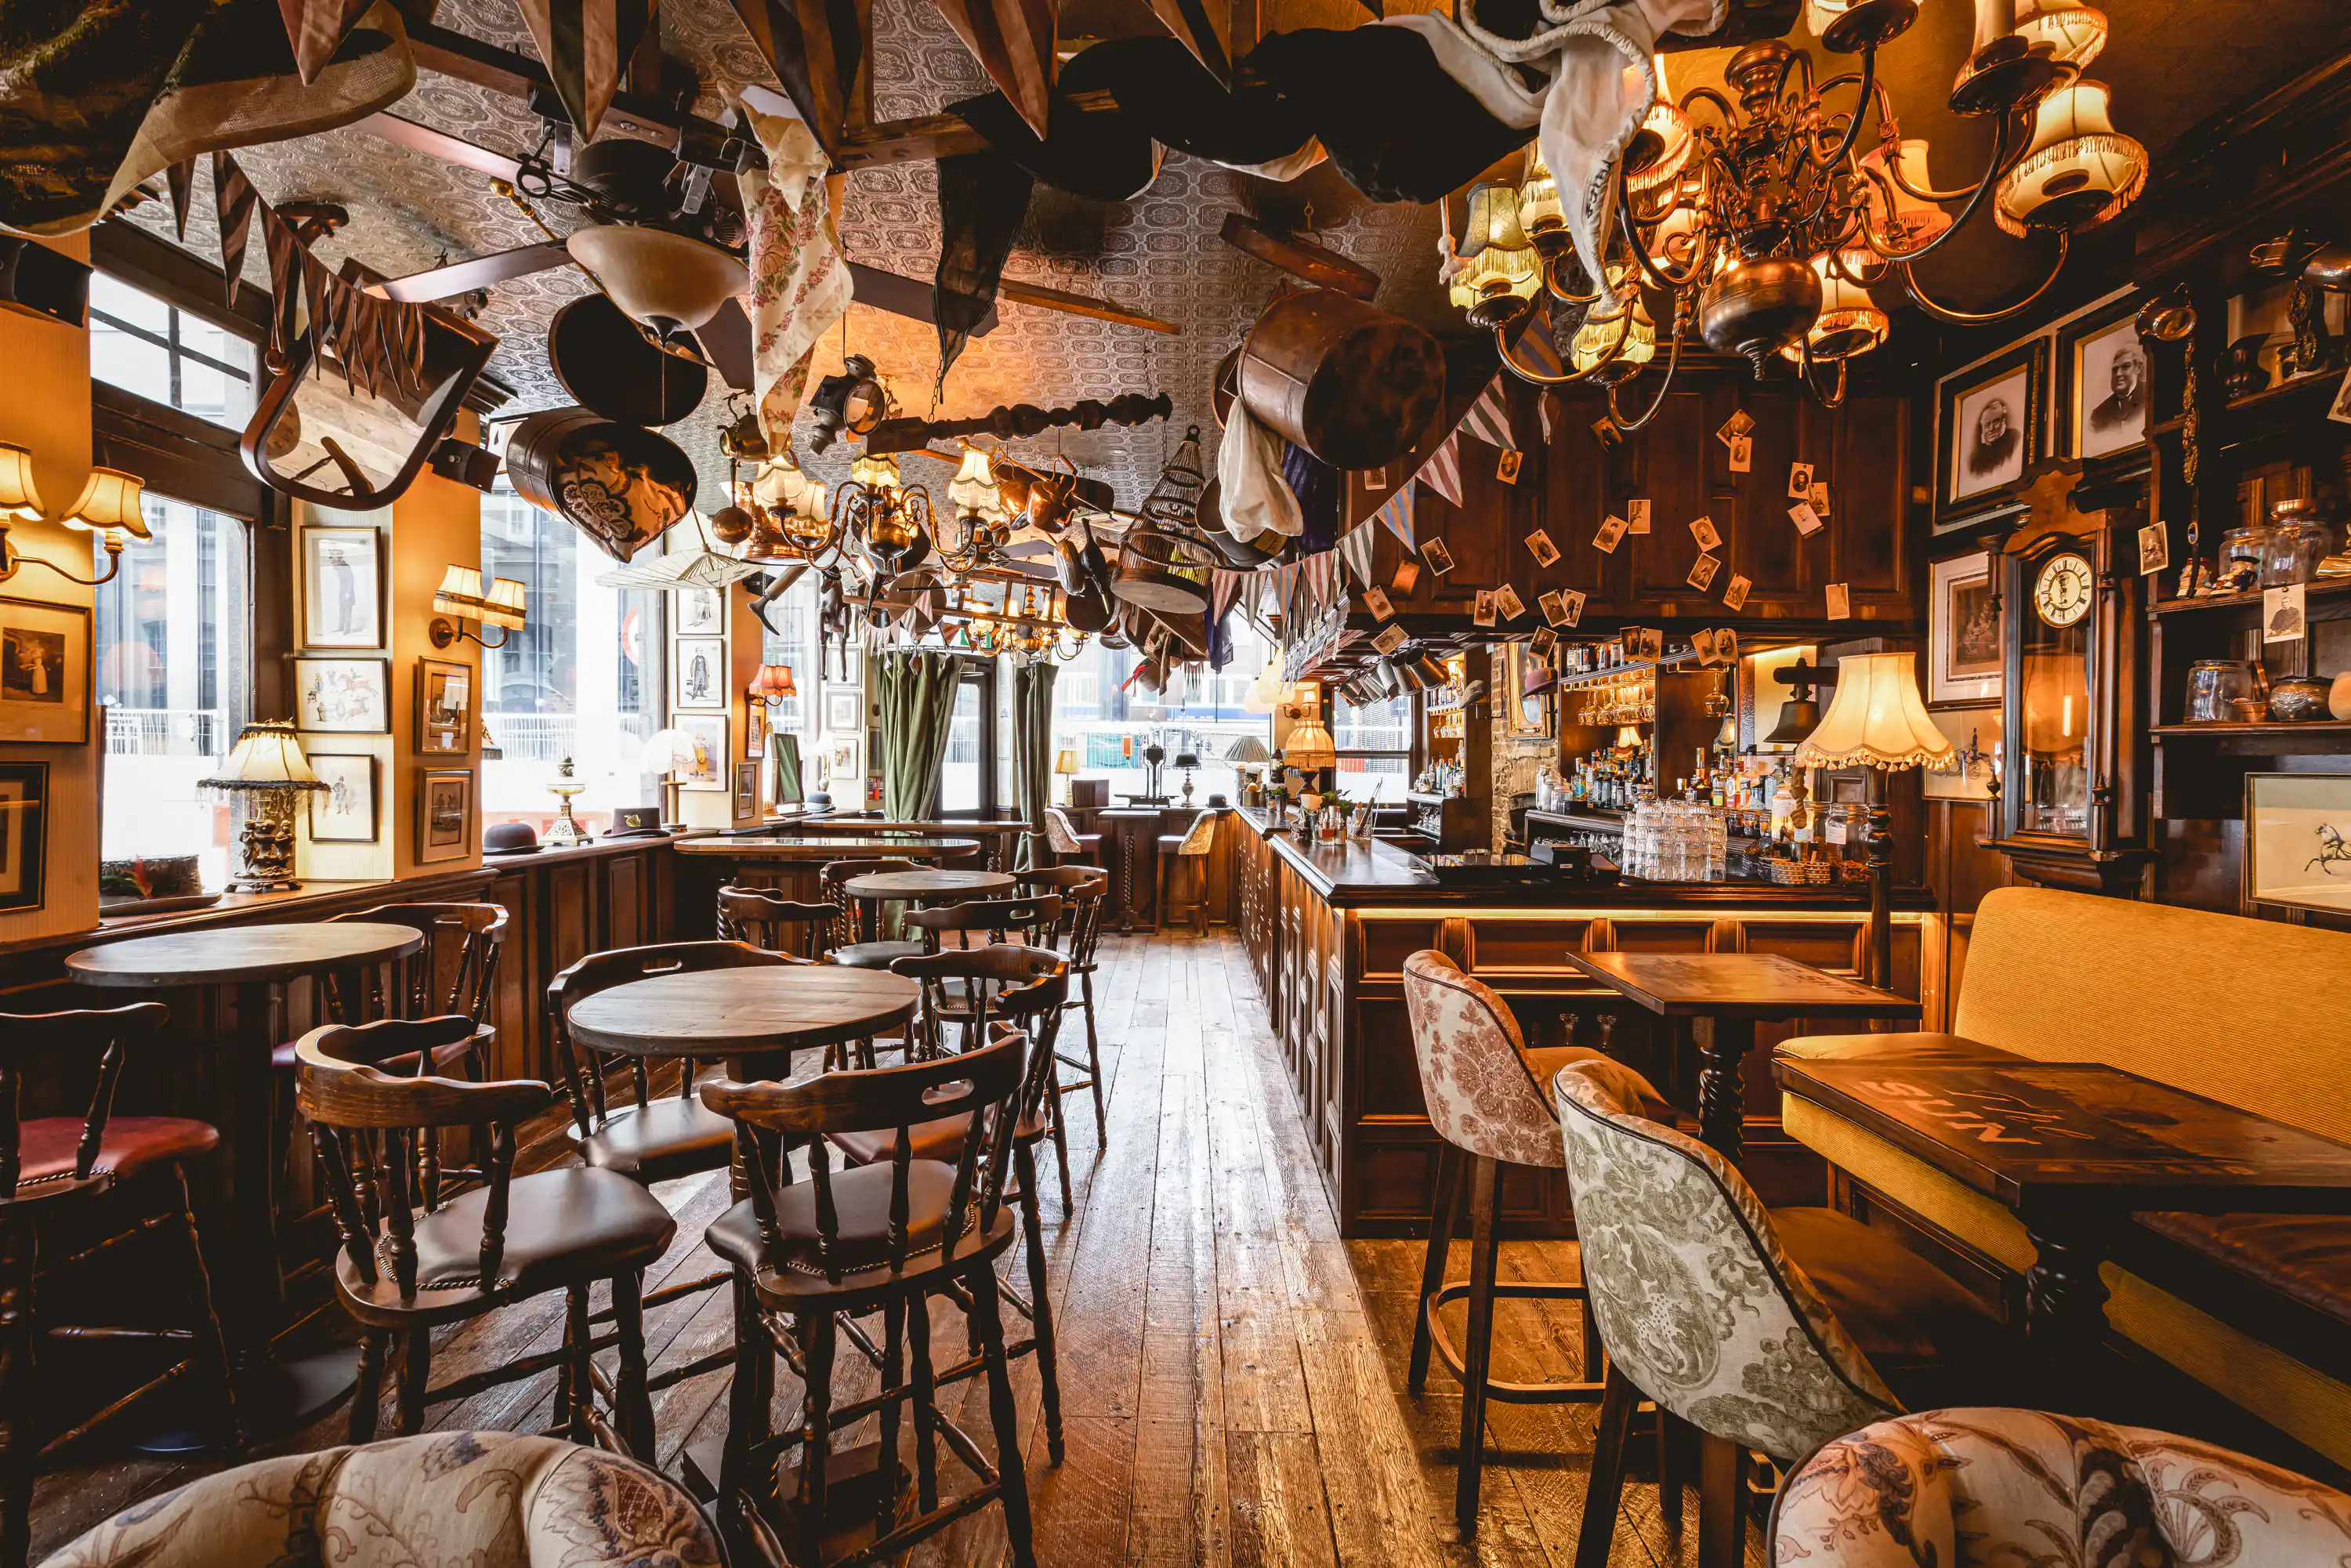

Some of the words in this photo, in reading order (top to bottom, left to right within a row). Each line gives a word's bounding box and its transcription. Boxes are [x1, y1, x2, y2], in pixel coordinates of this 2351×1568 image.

[1795, 976, 1867, 995] SHIP
[1861, 1081, 2042, 1145] SUN
[1943, 1089, 2096, 1140] The
